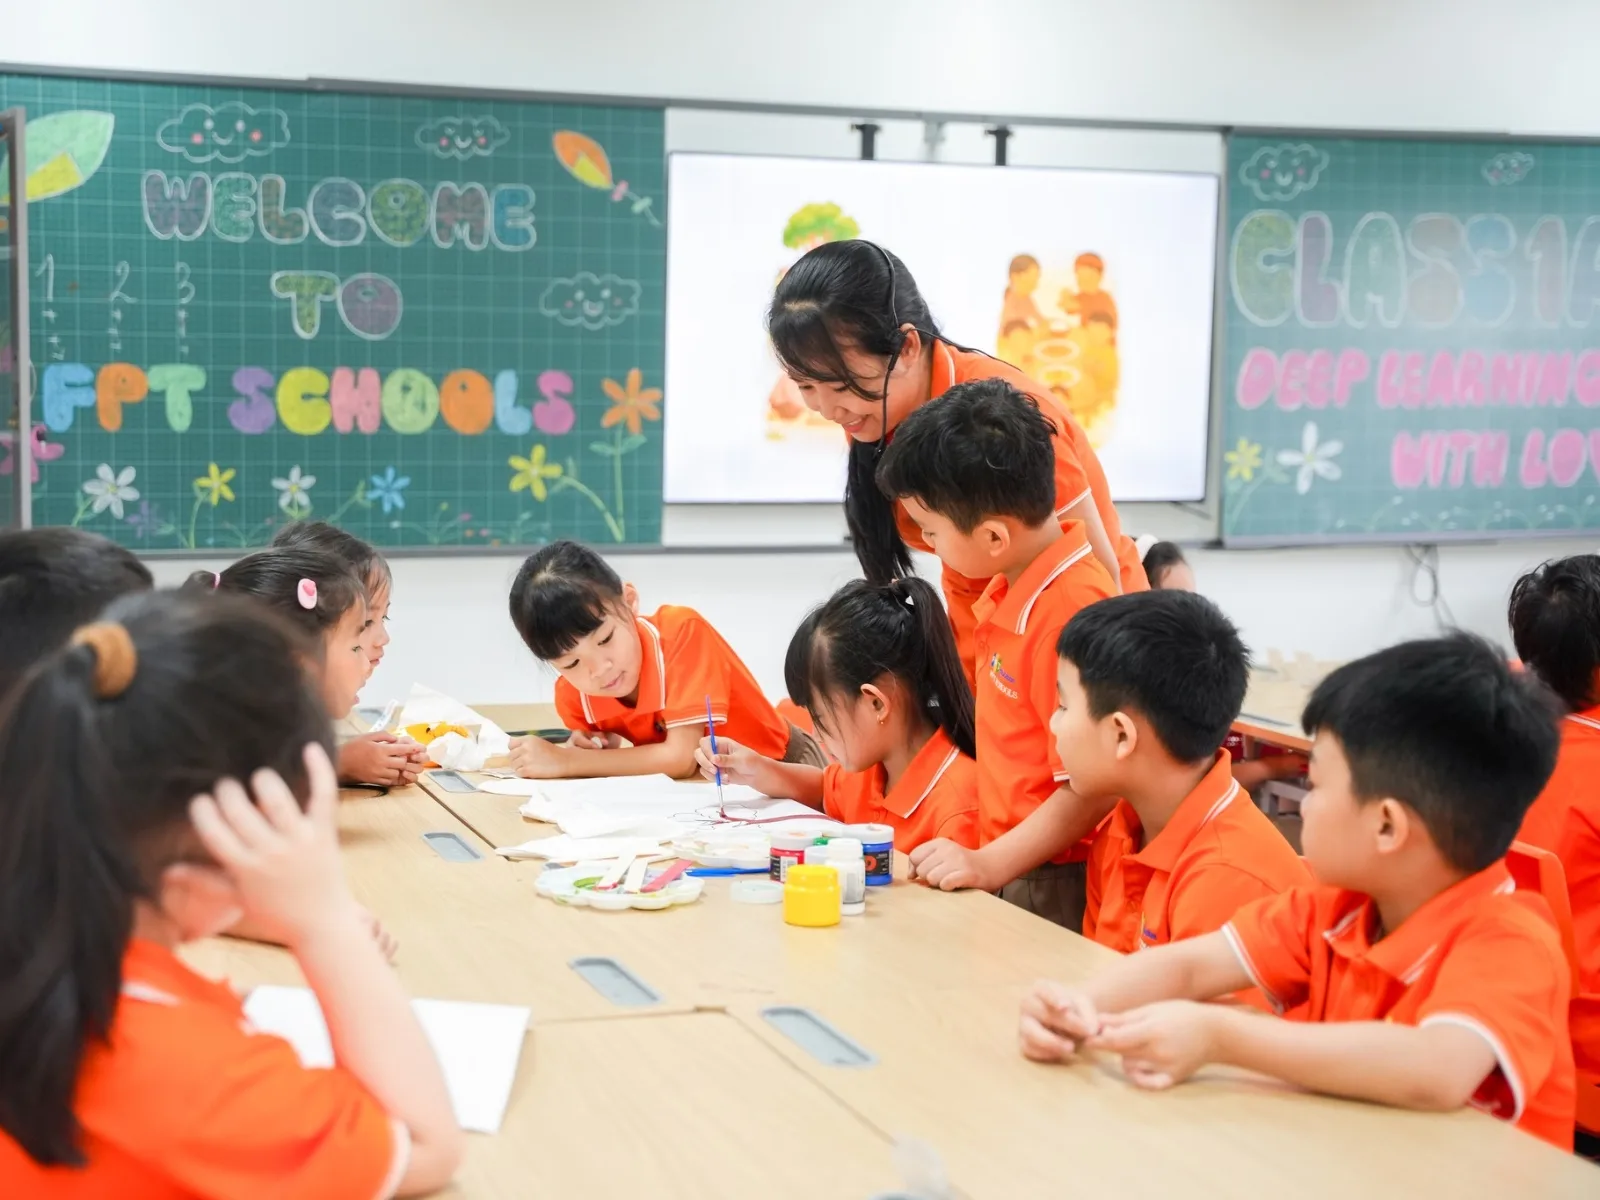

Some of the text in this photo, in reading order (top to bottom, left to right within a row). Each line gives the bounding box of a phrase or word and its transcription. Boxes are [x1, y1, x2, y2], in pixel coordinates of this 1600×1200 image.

[141, 169, 537, 251] WELCOME
[270, 270, 403, 340] TO
[1230, 209, 1517, 329] CLASS
[42, 362, 577, 436] FPT SCHOOLS
[1236, 347, 1370, 411] DEEP
[1390, 429, 1510, 489] WITH
